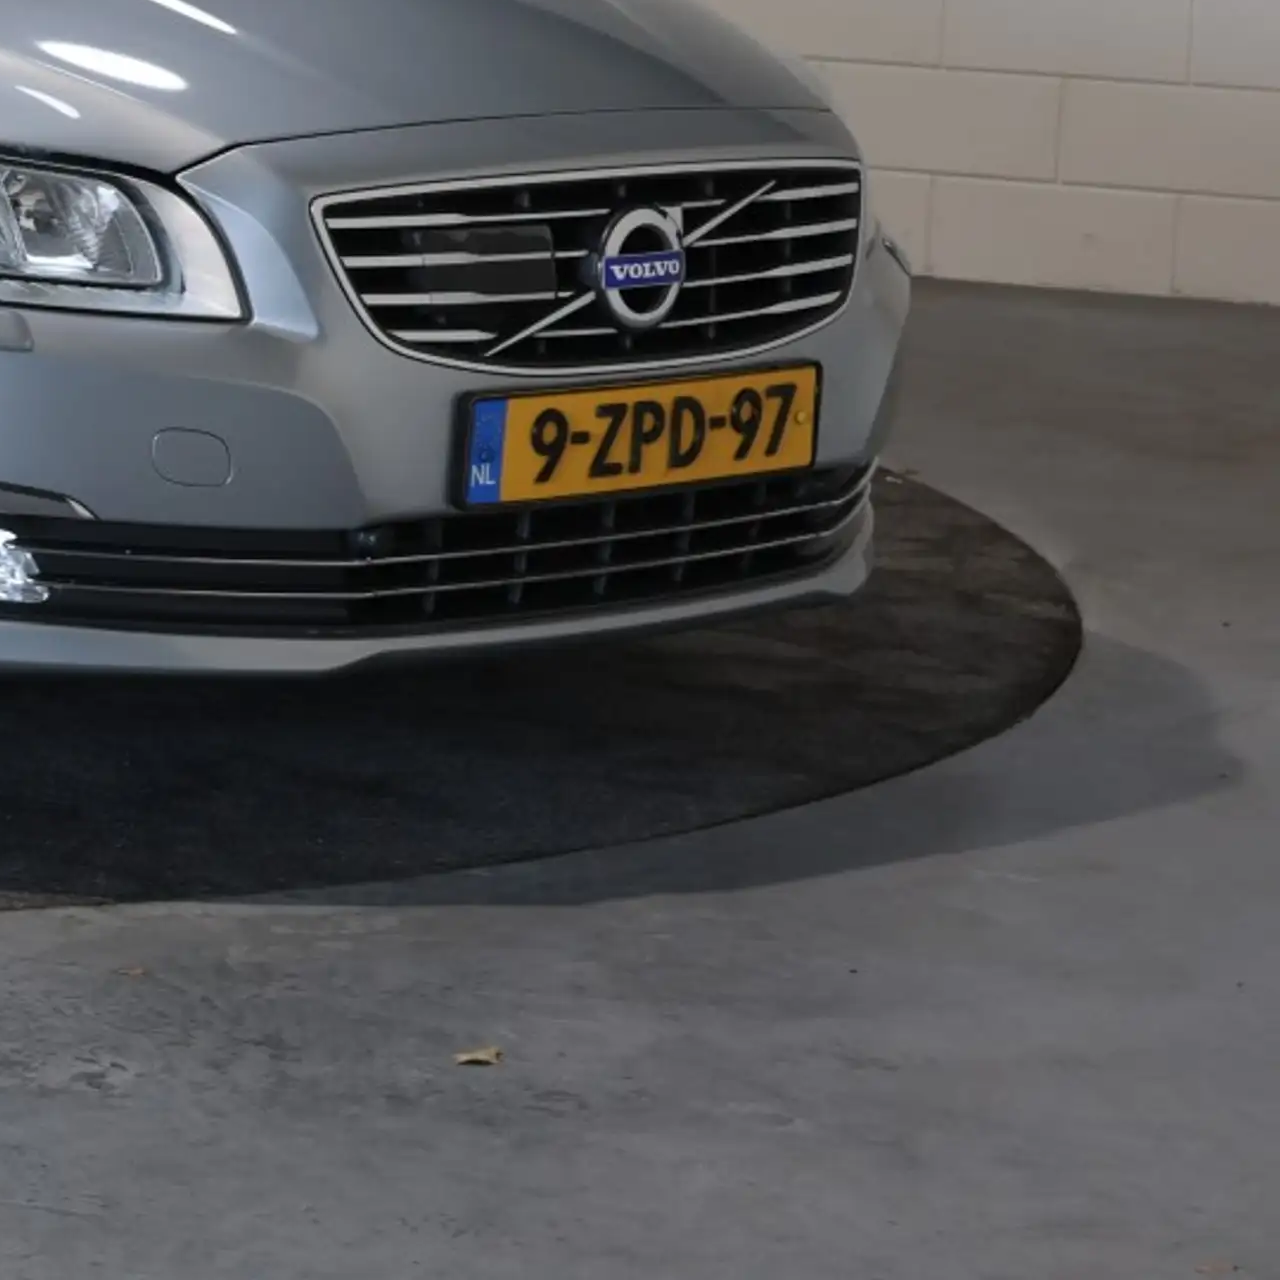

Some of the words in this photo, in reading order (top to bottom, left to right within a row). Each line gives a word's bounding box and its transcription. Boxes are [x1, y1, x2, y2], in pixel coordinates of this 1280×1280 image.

[609, 259, 680, 281] VOLVO
[531, 383, 797, 484] 9-ZPD-97
[470, 462, 496, 487] NL
